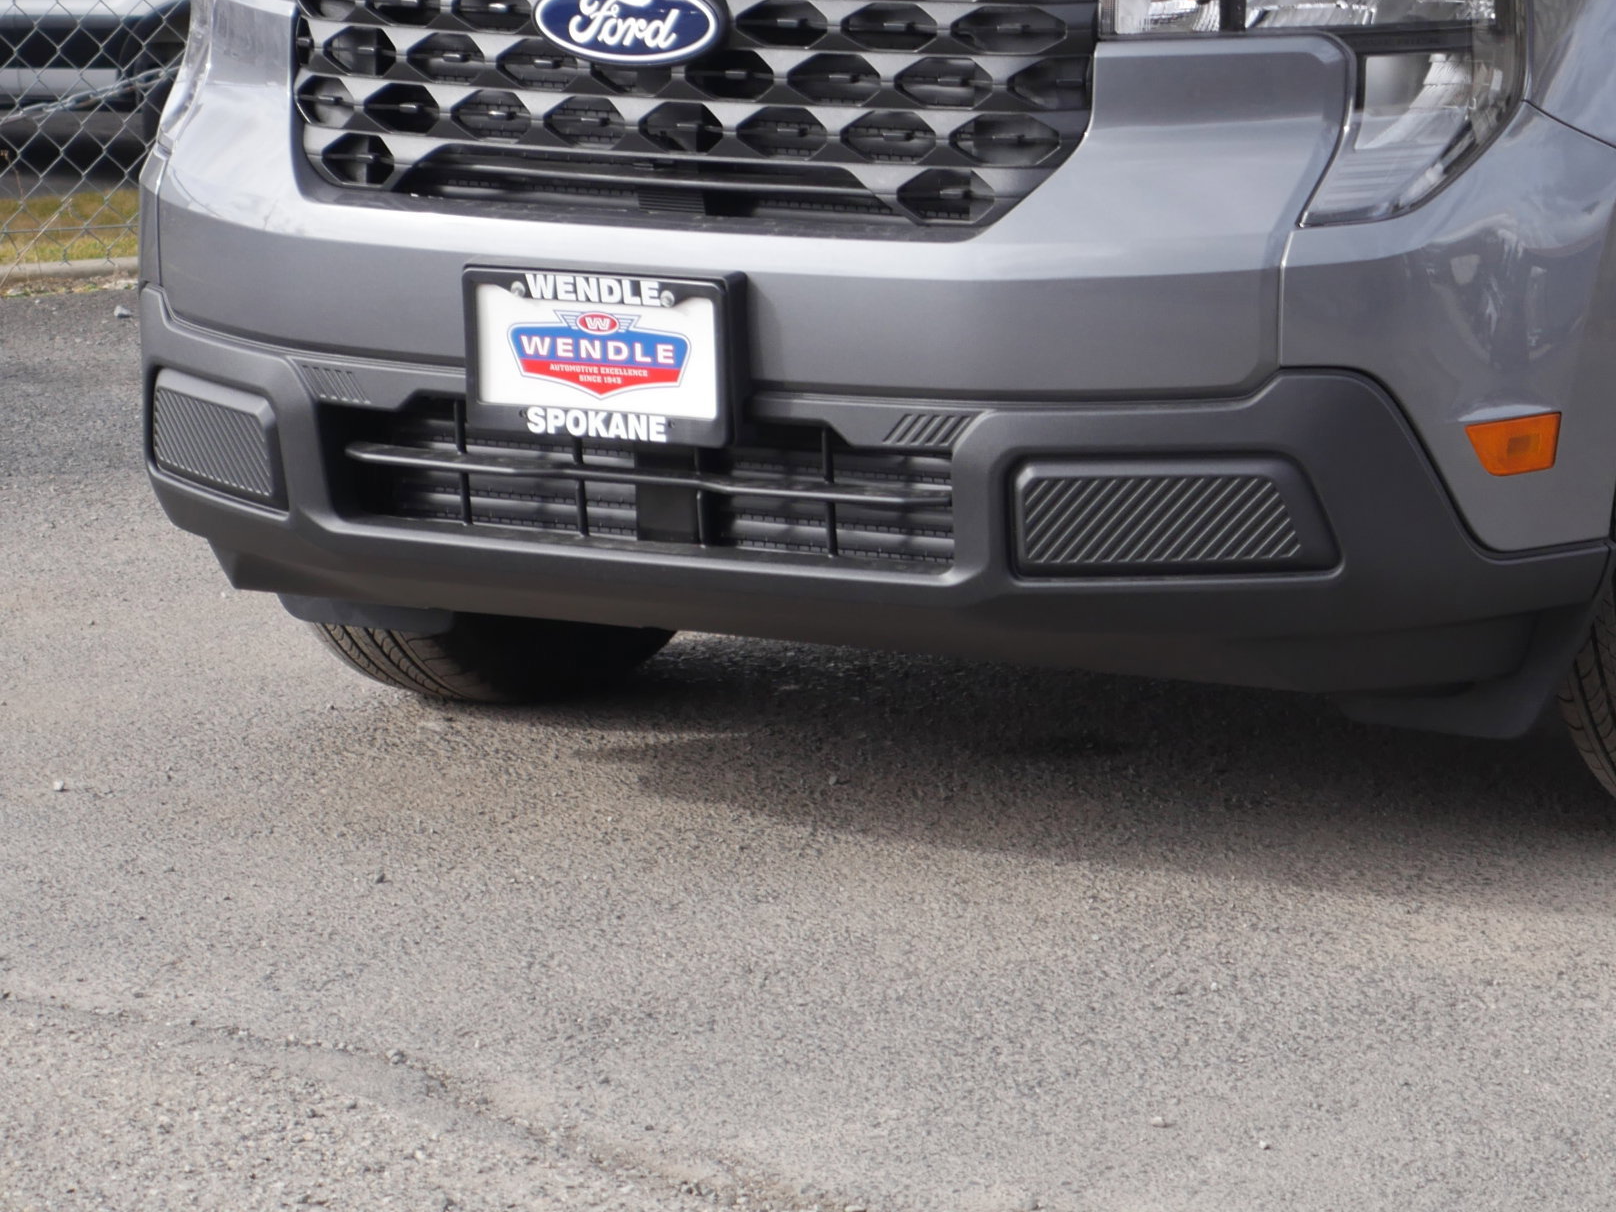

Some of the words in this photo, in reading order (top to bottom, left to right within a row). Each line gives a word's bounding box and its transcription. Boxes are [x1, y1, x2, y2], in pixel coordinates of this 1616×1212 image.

[525, 273, 661, 307] WENDLE
[520, 335, 675, 364] WENDLE
[549, 363, 599, 374] AUTOMOTIVE
[600, 366, 648, 377] EXCELLENCE
[526, 405, 667, 443] SPOKANE
